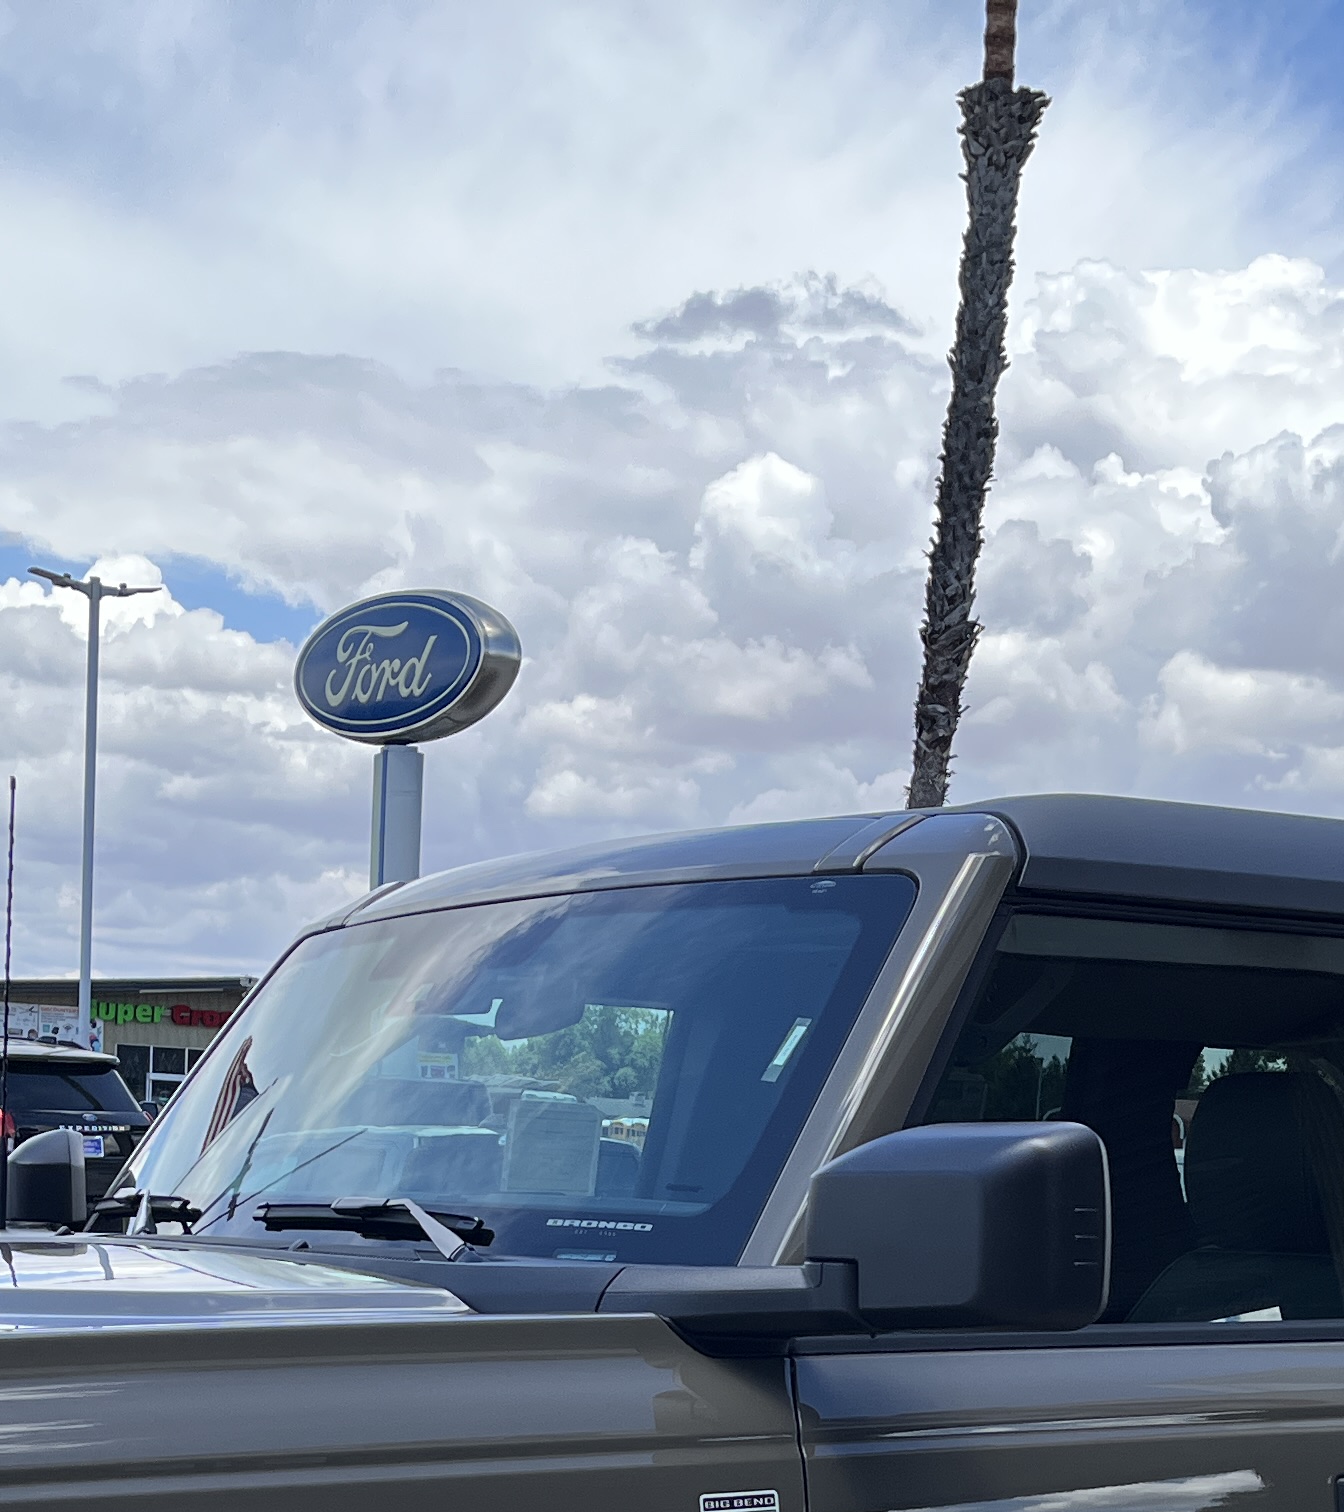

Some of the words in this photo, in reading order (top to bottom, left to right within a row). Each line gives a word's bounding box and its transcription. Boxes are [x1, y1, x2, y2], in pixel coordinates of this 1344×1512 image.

[324, 620, 439, 707] Ford
[546, 1218, 653, 1232] BRONCO
[704, 1499, 731, 1509] BIG
[733, 1496, 775, 1508] BEND
